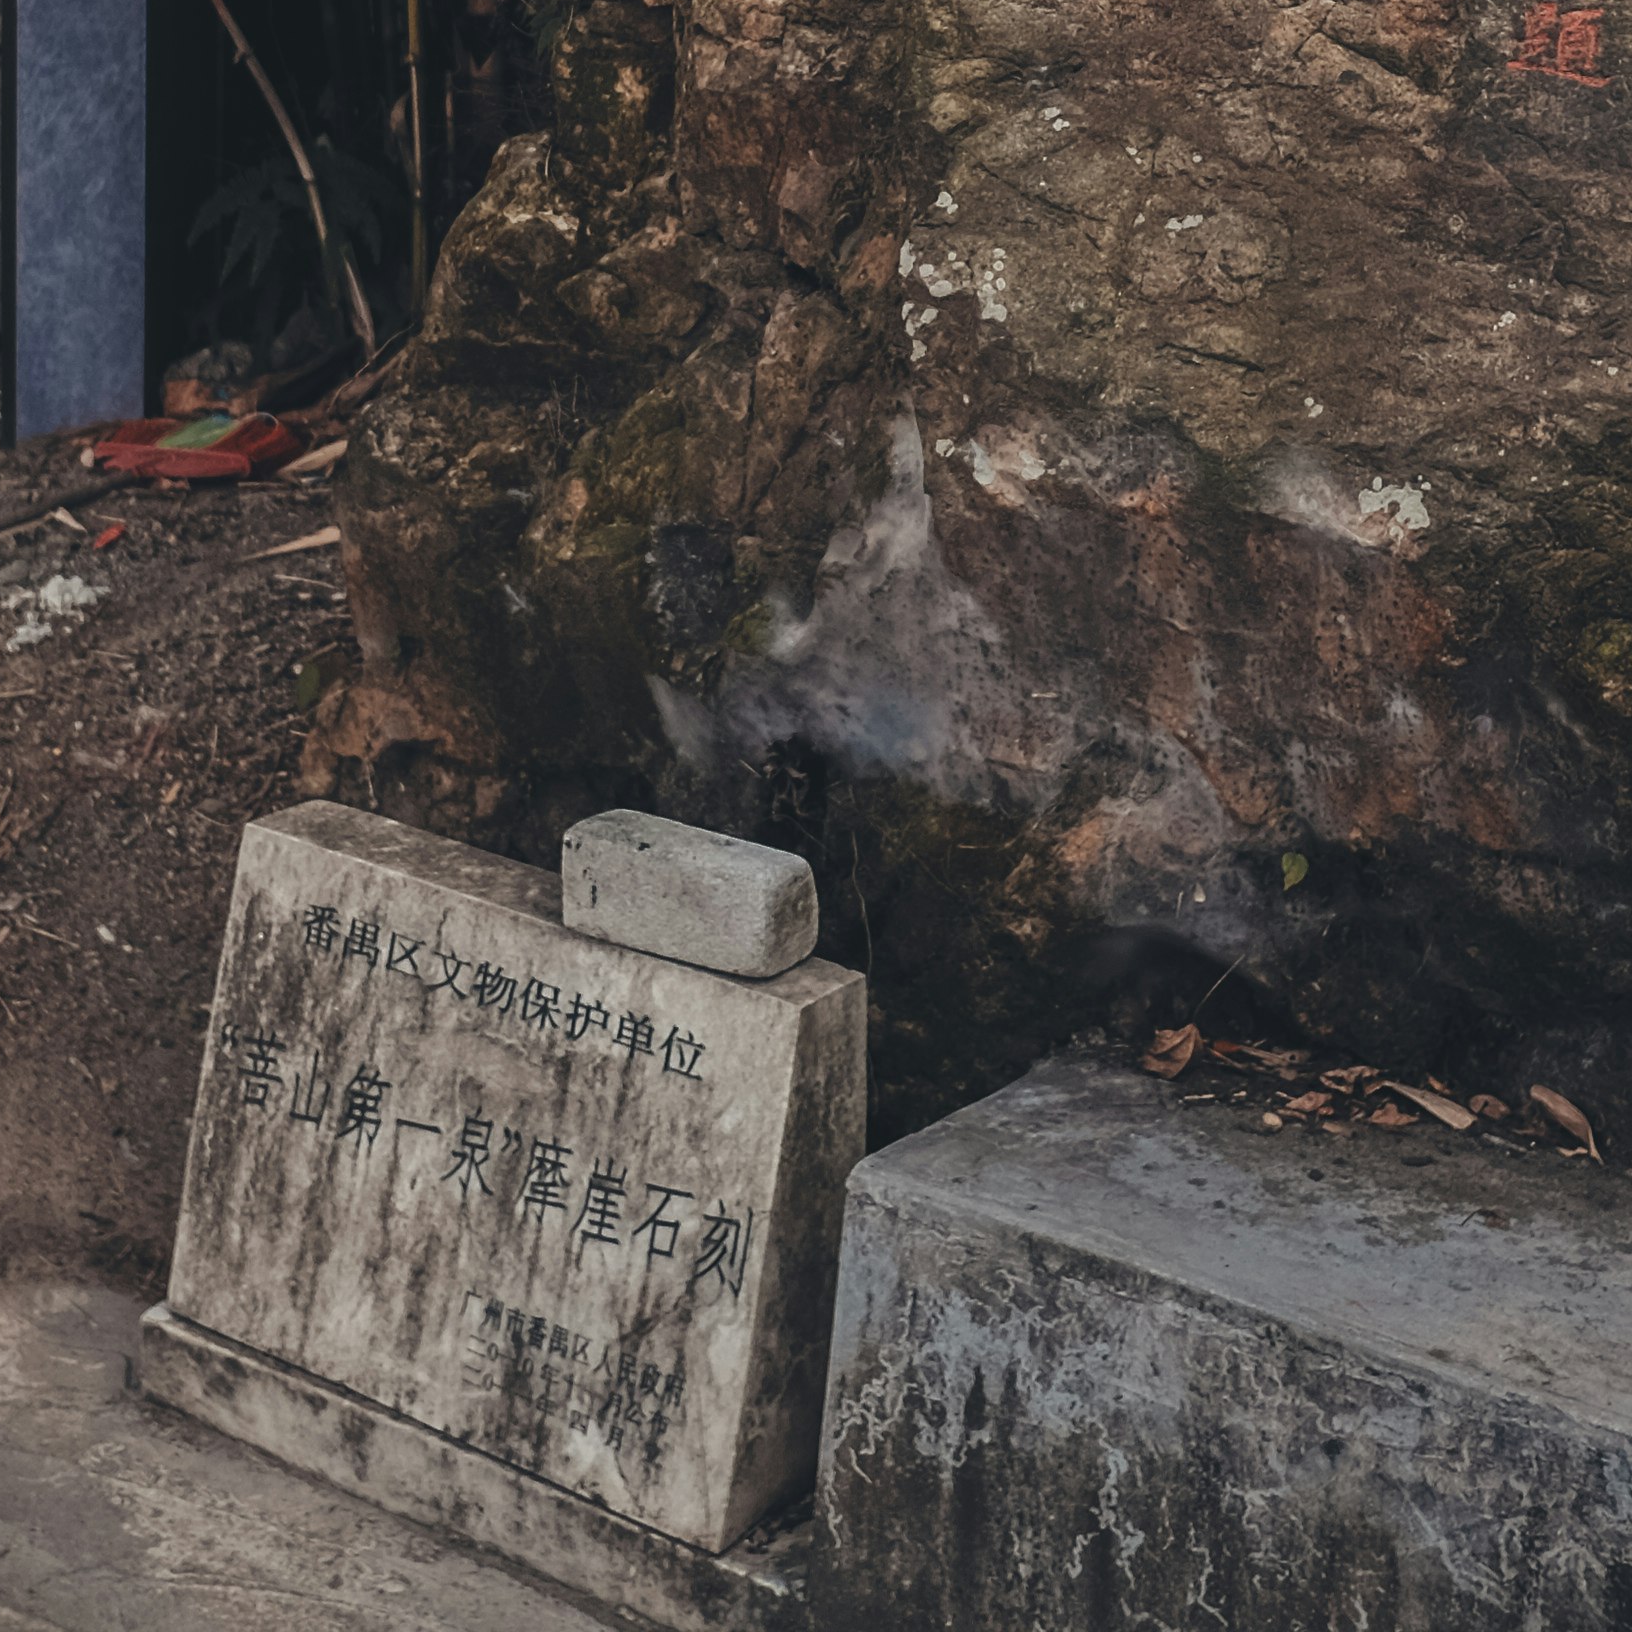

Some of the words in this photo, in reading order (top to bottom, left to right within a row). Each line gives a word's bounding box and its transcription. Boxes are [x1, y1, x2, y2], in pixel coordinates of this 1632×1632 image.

[302, 903, 707, 1082] 番禺区文物保护单位
[460, 1287, 687, 1407] 广州市番禺区人民政府
